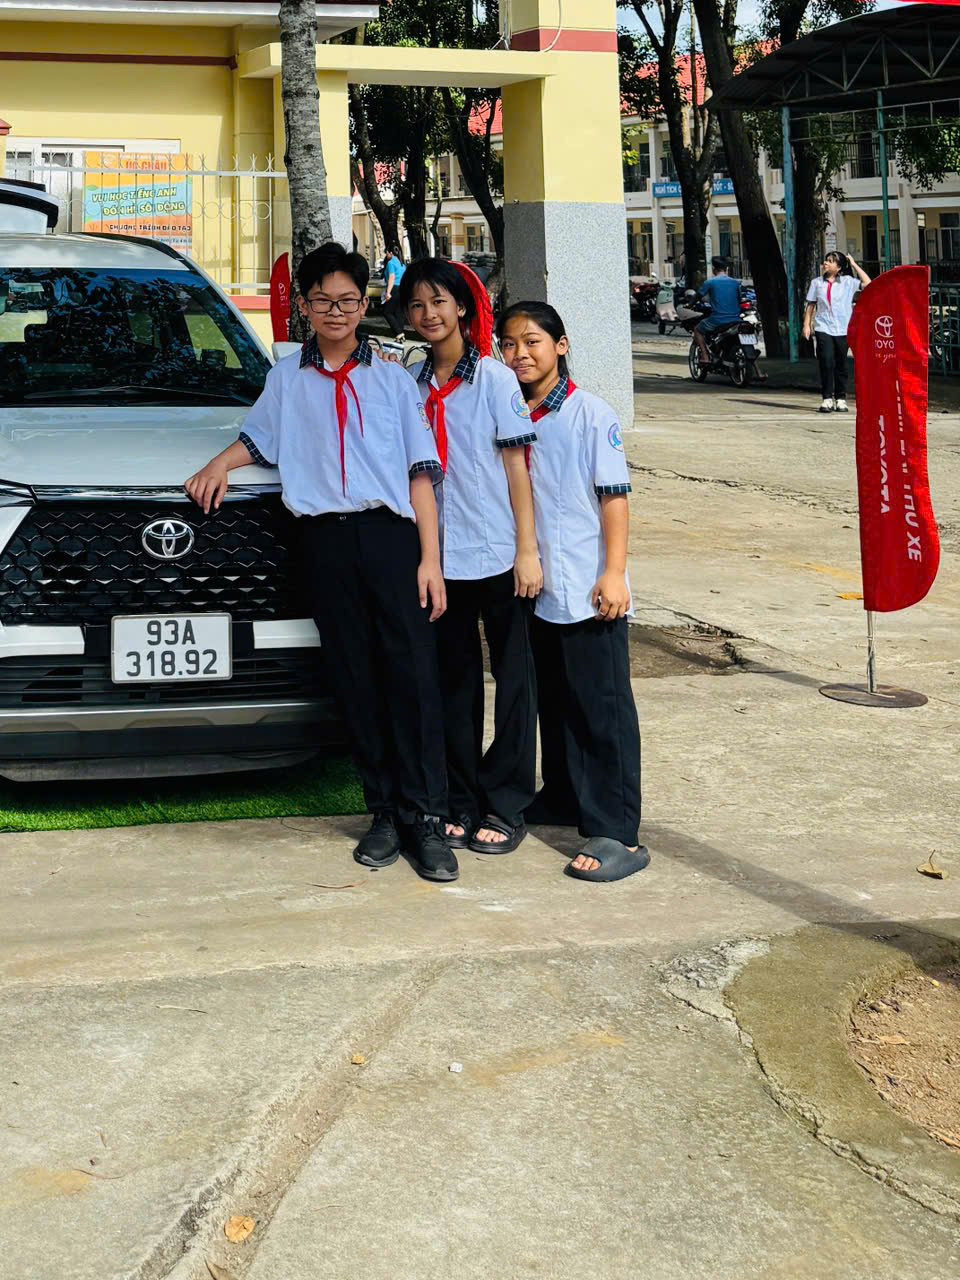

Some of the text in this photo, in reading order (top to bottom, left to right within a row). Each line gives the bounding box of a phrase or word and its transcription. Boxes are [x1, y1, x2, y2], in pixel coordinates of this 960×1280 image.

[157, 187, 177, 197] ANH
[907, 531, 922, 562] XE
[147, 619, 196, 646] 93A
[126, 649, 217, 677] 318.92
